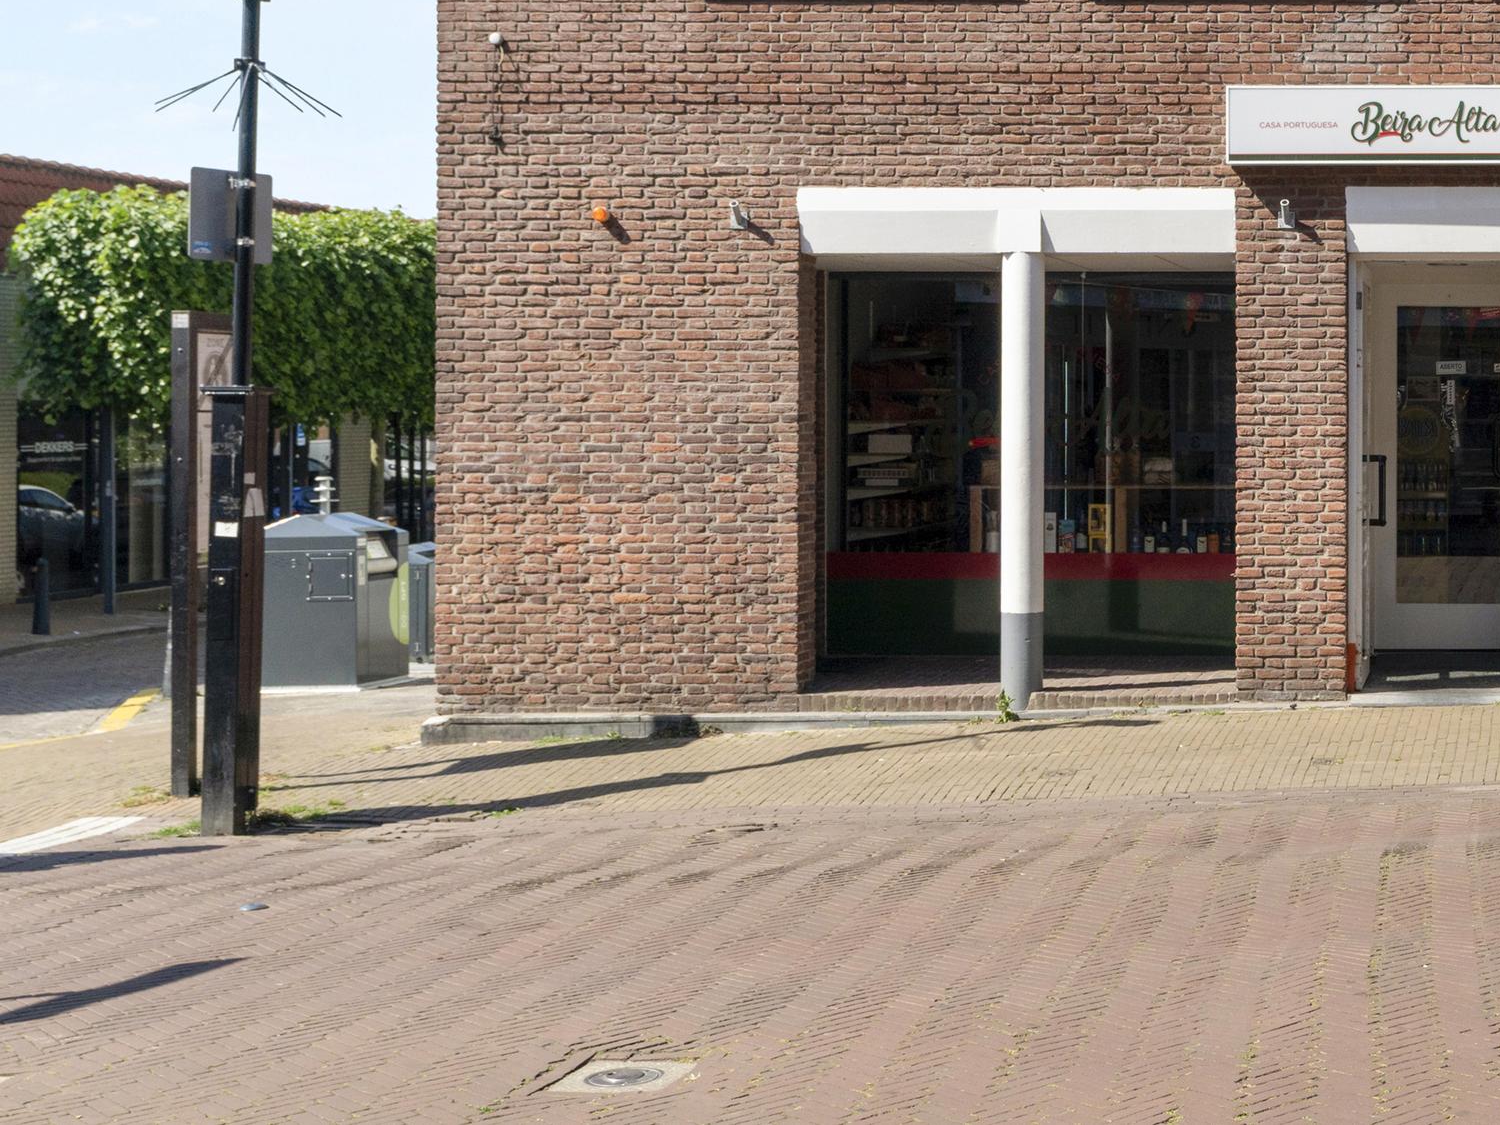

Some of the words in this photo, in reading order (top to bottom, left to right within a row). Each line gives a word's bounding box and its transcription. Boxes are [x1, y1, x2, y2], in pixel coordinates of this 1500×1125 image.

[1259, 121, 1282, 129] CASA
[1283, 121, 1338, 129] PORTUGUESA
[1351, 101, 1428, 146] Beira
[34, 441, 74, 453] DEKKERS
